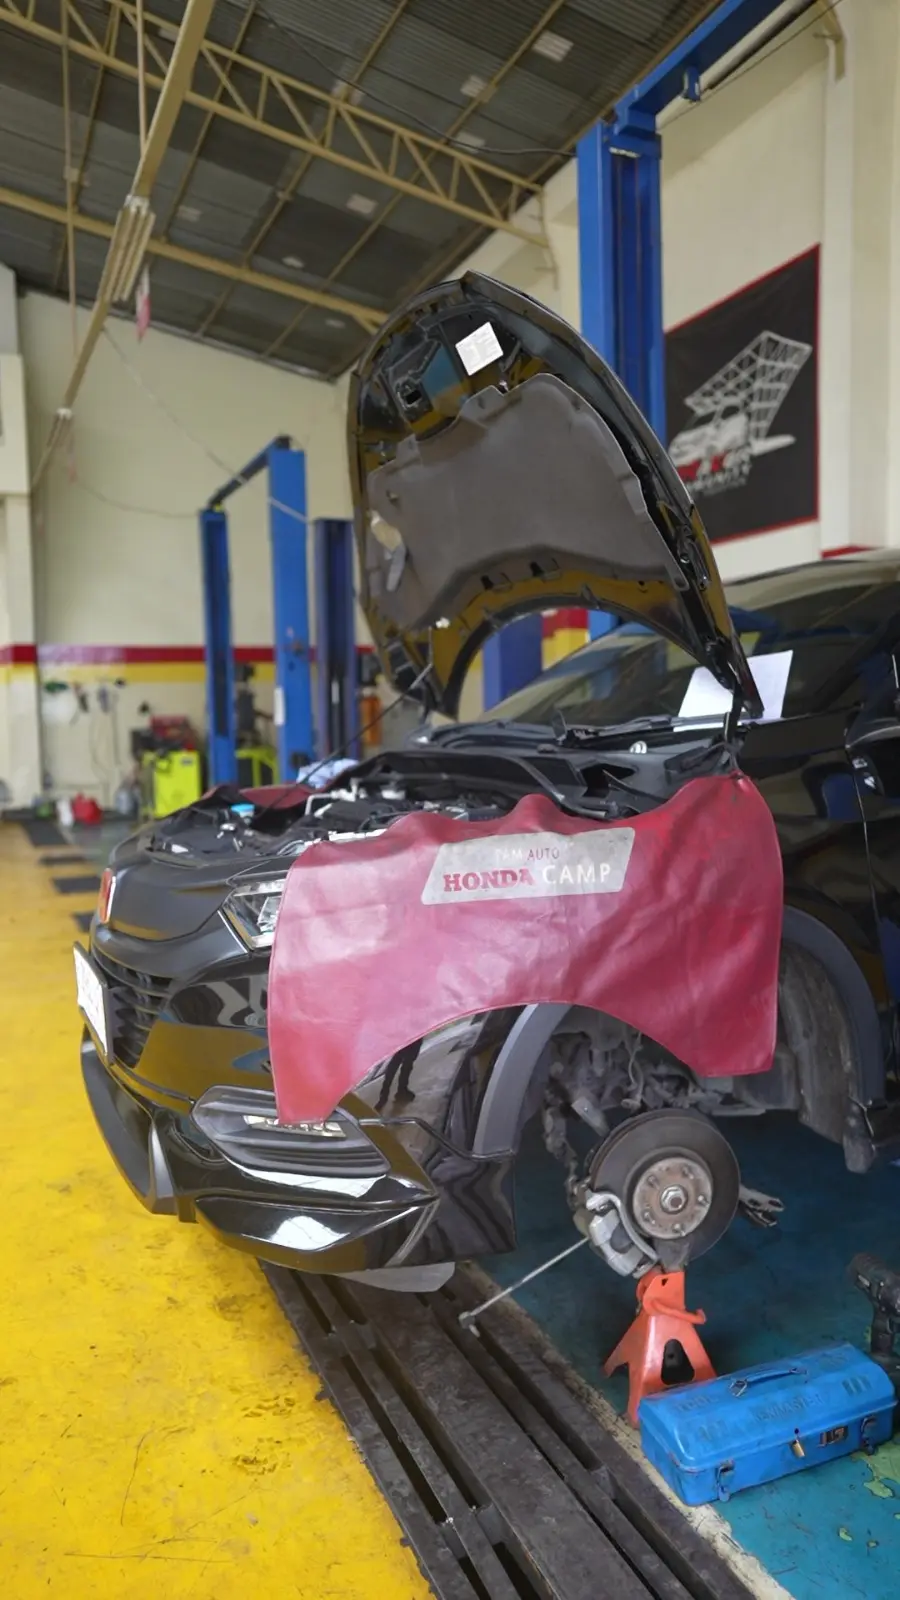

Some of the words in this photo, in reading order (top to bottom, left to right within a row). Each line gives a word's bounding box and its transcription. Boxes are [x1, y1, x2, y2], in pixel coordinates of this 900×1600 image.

[527, 847, 560, 861] AUTO
[443, 868, 535, 892] HONDA
[542, 863, 611, 884] CAMP
